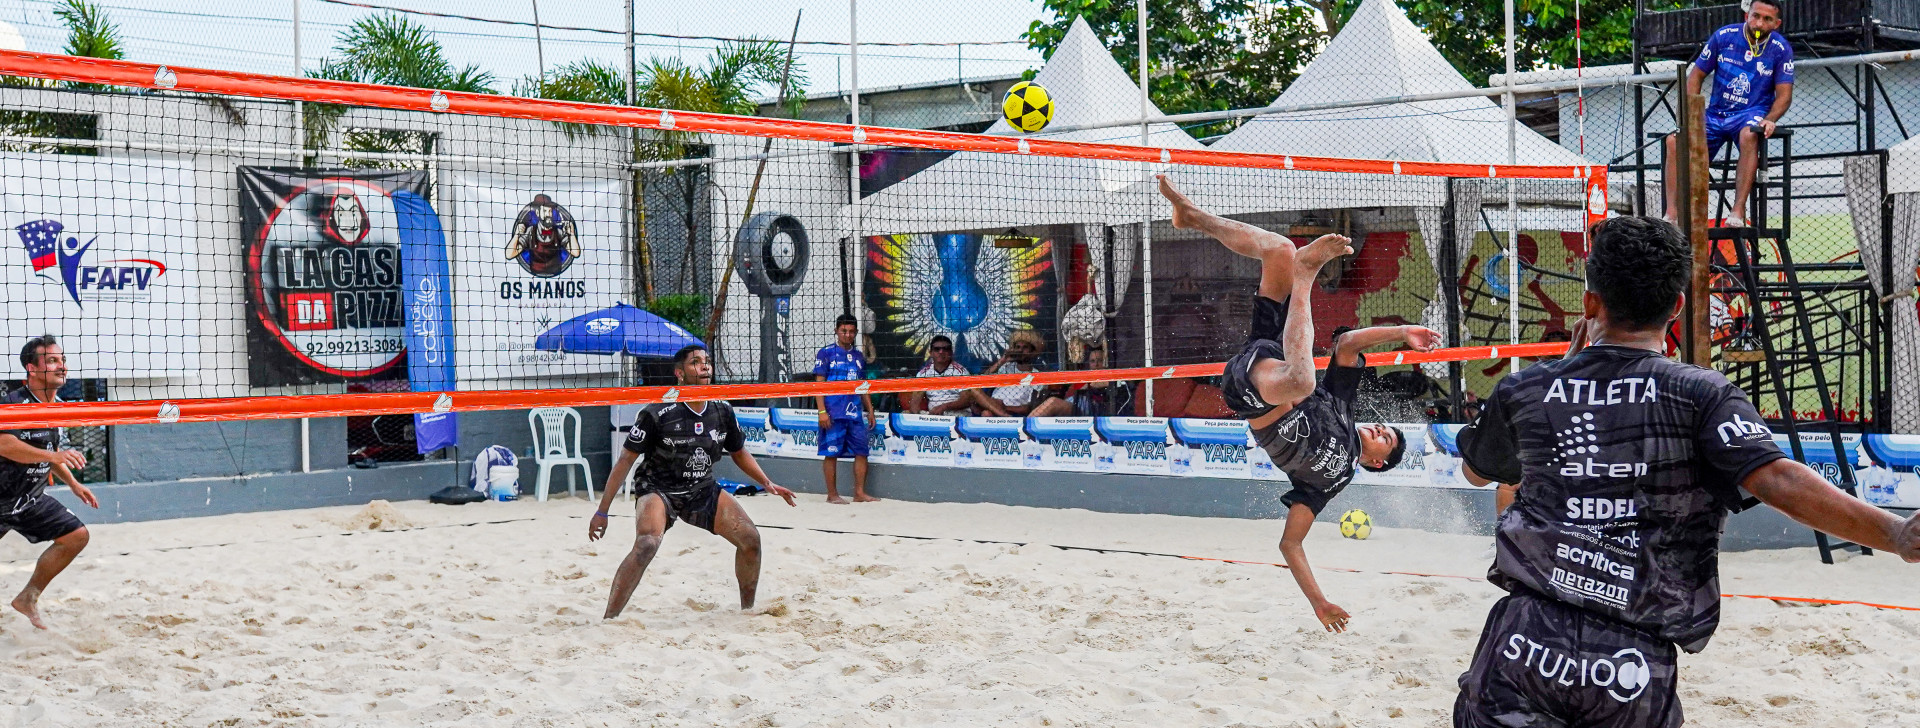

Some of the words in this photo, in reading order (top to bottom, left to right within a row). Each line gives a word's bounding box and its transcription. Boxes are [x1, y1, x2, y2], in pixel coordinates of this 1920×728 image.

[81, 266, 152, 290] FAFV
[282, 247, 326, 289] LA
[500, 281, 522, 299] OS
[529, 280, 585, 299] MANOS
[297, 299, 327, 325] DA
[415, 277, 437, 363] cabello
[1543, 377, 1656, 406] ATLETA
[914, 435, 952, 453] YARA
[981, 437, 1021, 455] YARA
[1051, 439, 1092, 458] YARA
[1123, 440, 1166, 460] YARA
[1201, 443, 1248, 464] YARA
[1566, 497, 1637, 519] SEDEL
